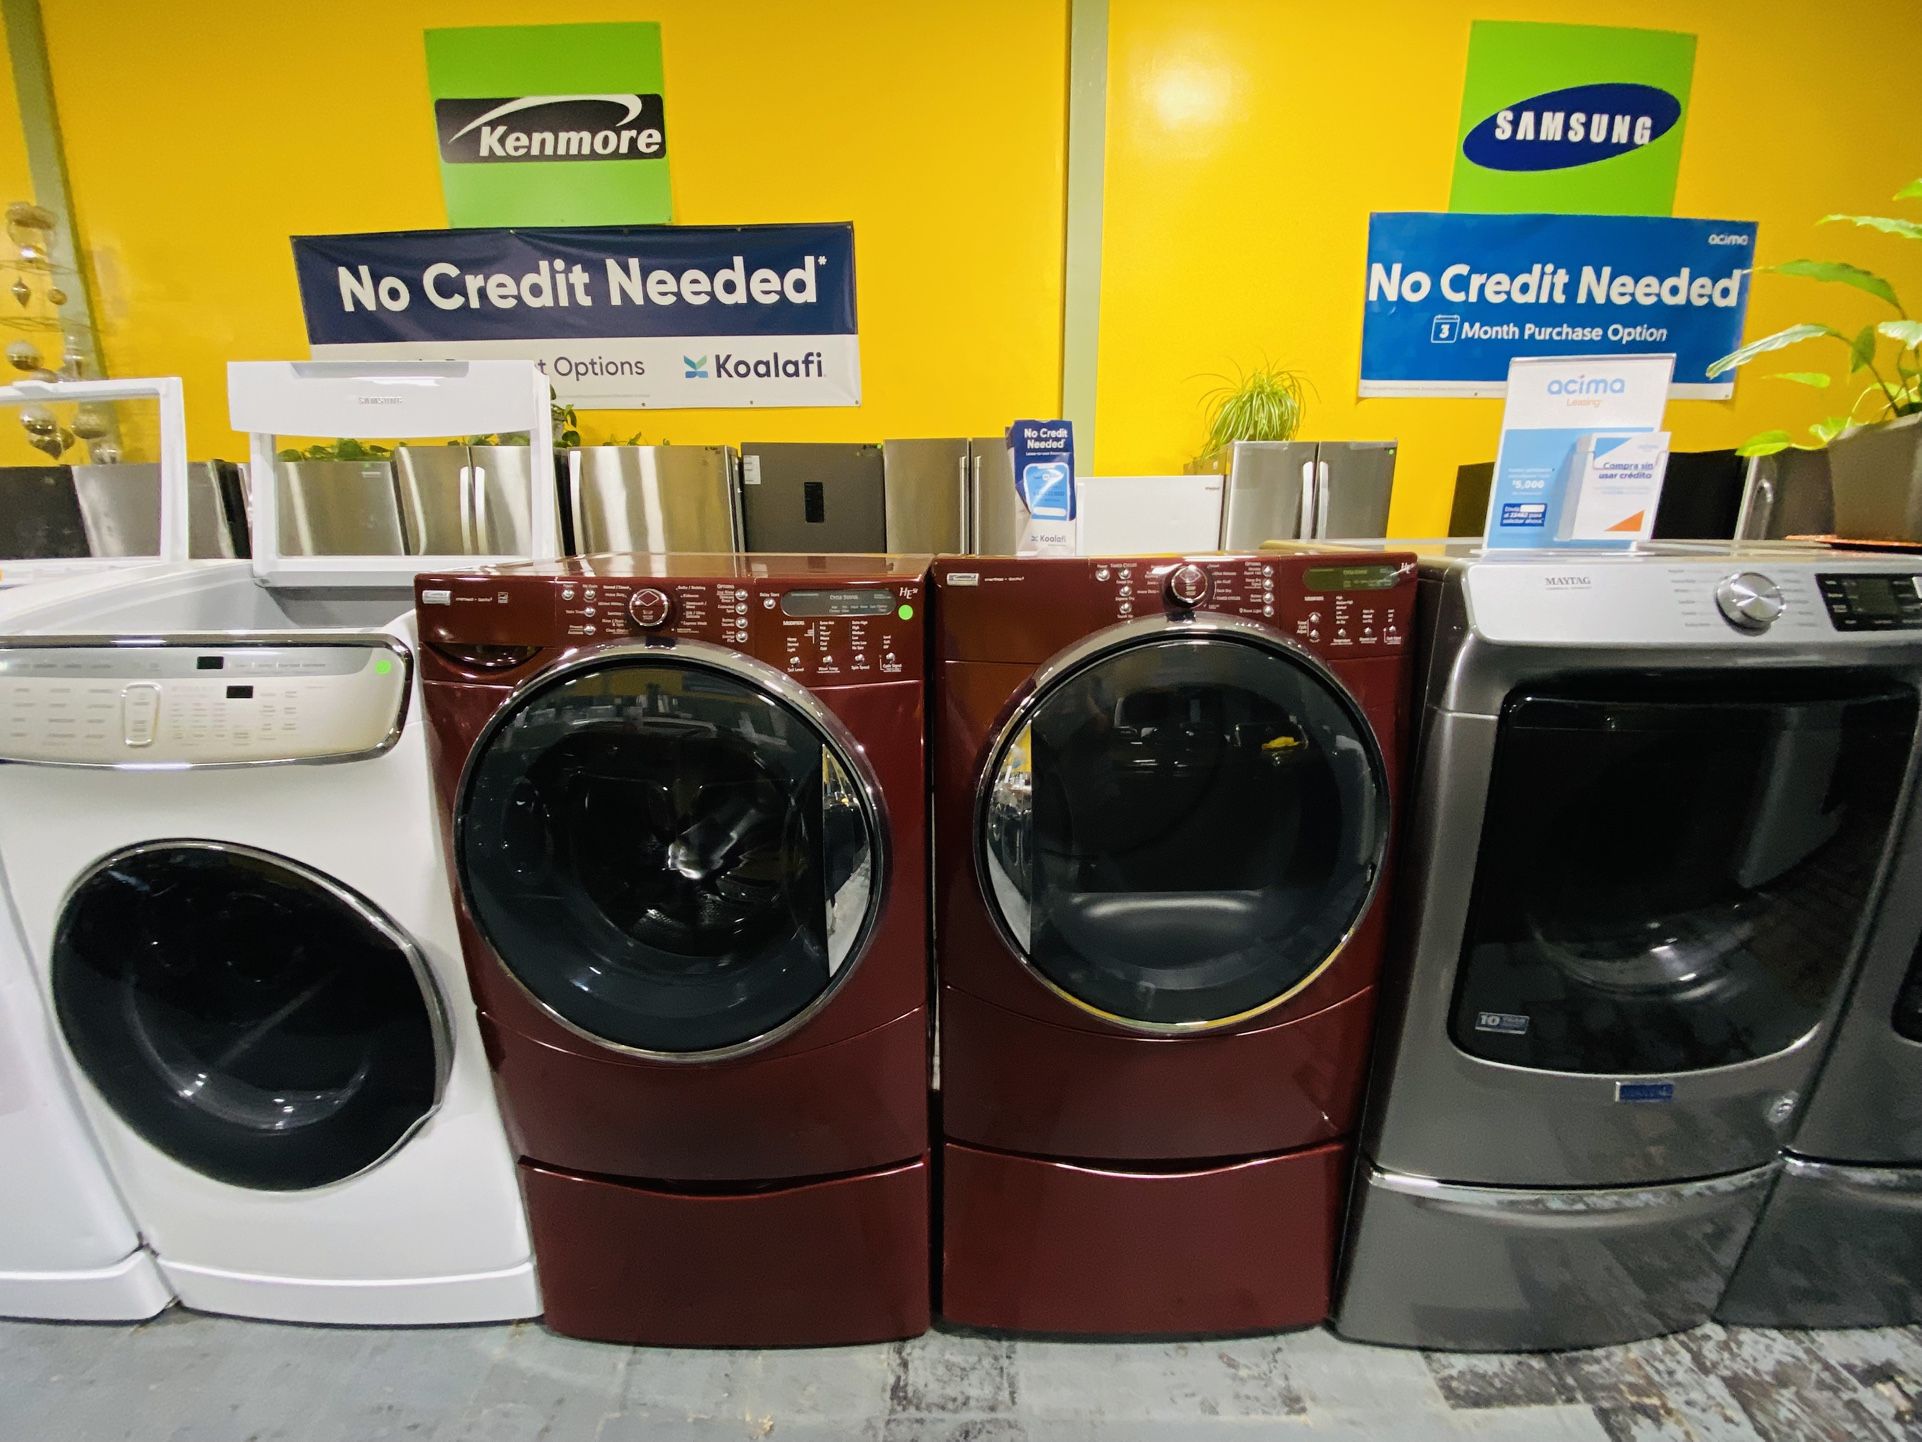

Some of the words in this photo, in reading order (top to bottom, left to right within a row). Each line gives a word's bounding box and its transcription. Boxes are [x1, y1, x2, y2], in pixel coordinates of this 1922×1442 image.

[1495, 110, 1653, 145] SAMSUNG
[479, 125, 662, 157] Kenmore
[1708, 233, 1749, 246] acima
[338, 265, 410, 312] No
[423, 259, 592, 310] Credit
[1368, 262, 1432, 302] No
[1440, 262, 1569, 304] Credit
[1461, 321, 1519, 340] Month
[1524, 323, 1603, 342] Purchase
[1607, 323, 1667, 345] Option
[553, 356, 645, 382] Options
[714, 352, 823, 379] Koalafi
[1547, 374, 1626, 396] acima
[1024, 427, 1039, 438] No
[1040, 427, 1068, 438] Credit
[1544, 576, 1592, 586] MAYTAG
[1480, 1014, 1501, 1026] 10
